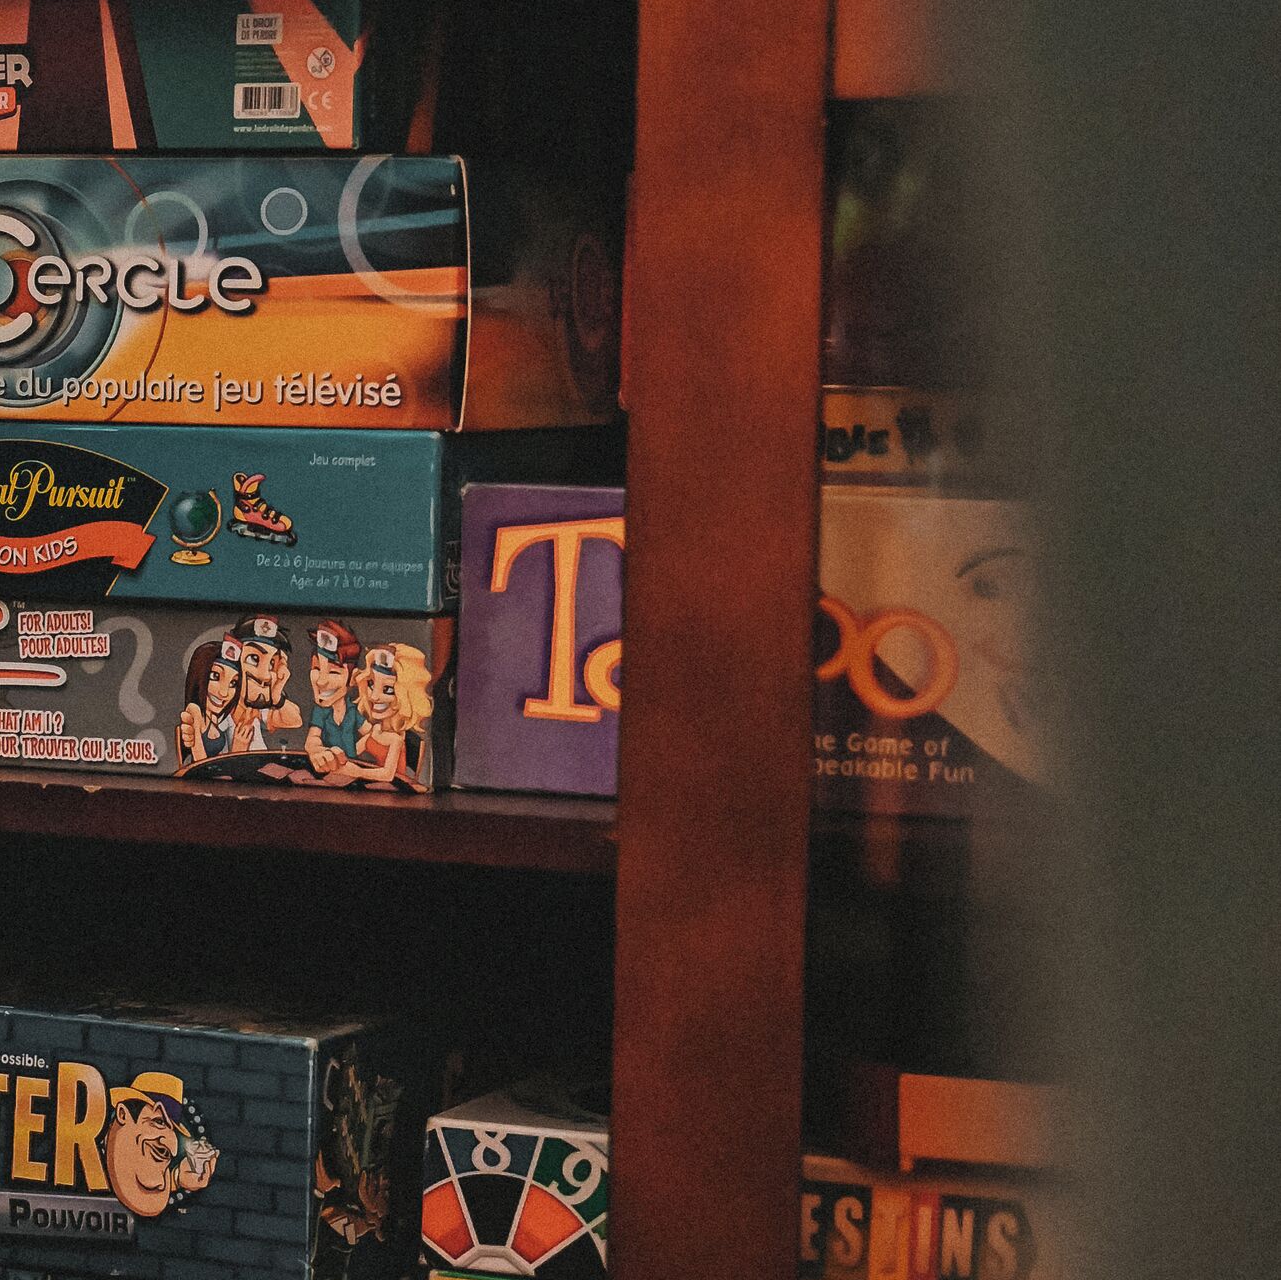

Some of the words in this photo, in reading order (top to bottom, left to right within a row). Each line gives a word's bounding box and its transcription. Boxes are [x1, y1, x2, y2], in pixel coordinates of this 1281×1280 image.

[15, 368, 52, 397] du
[62, 372, 205, 408] populaire
[213, 370, 263, 411] jeu
[273, 372, 402, 407] télévisé
[309, 453, 329, 466] Jeu
[331, 454, 377, 471] complet
[4, 460, 125, 521] Pursuit
[33, 535, 78, 564] KIDS
[256, 553, 271, 567] De
[273, 554, 281, 567] 2
[283, 552, 291, 567] à
[293, 555, 302, 567] 6
[316, 573, 330, 587] de
[352, 576, 366, 589] 10
[368, 578, 390, 590] ans
[20, 613, 42, 632] FOR
[46, 612, 91, 632] ADULTS!
[20, 637, 52, 656] POUR
[56, 636, 108, 655] ADULTES!
[23, 712, 42, 732] AM
[21, 737, 77, 758] TROUVER
[82, 739, 102, 760] QUI
[106, 740, 122, 760] JE
[125, 742, 156, 761] SUIS.
[846, 732, 914, 757] Game
[923, 737, 950, 758] of
[928, 760, 975, 784] Fun
